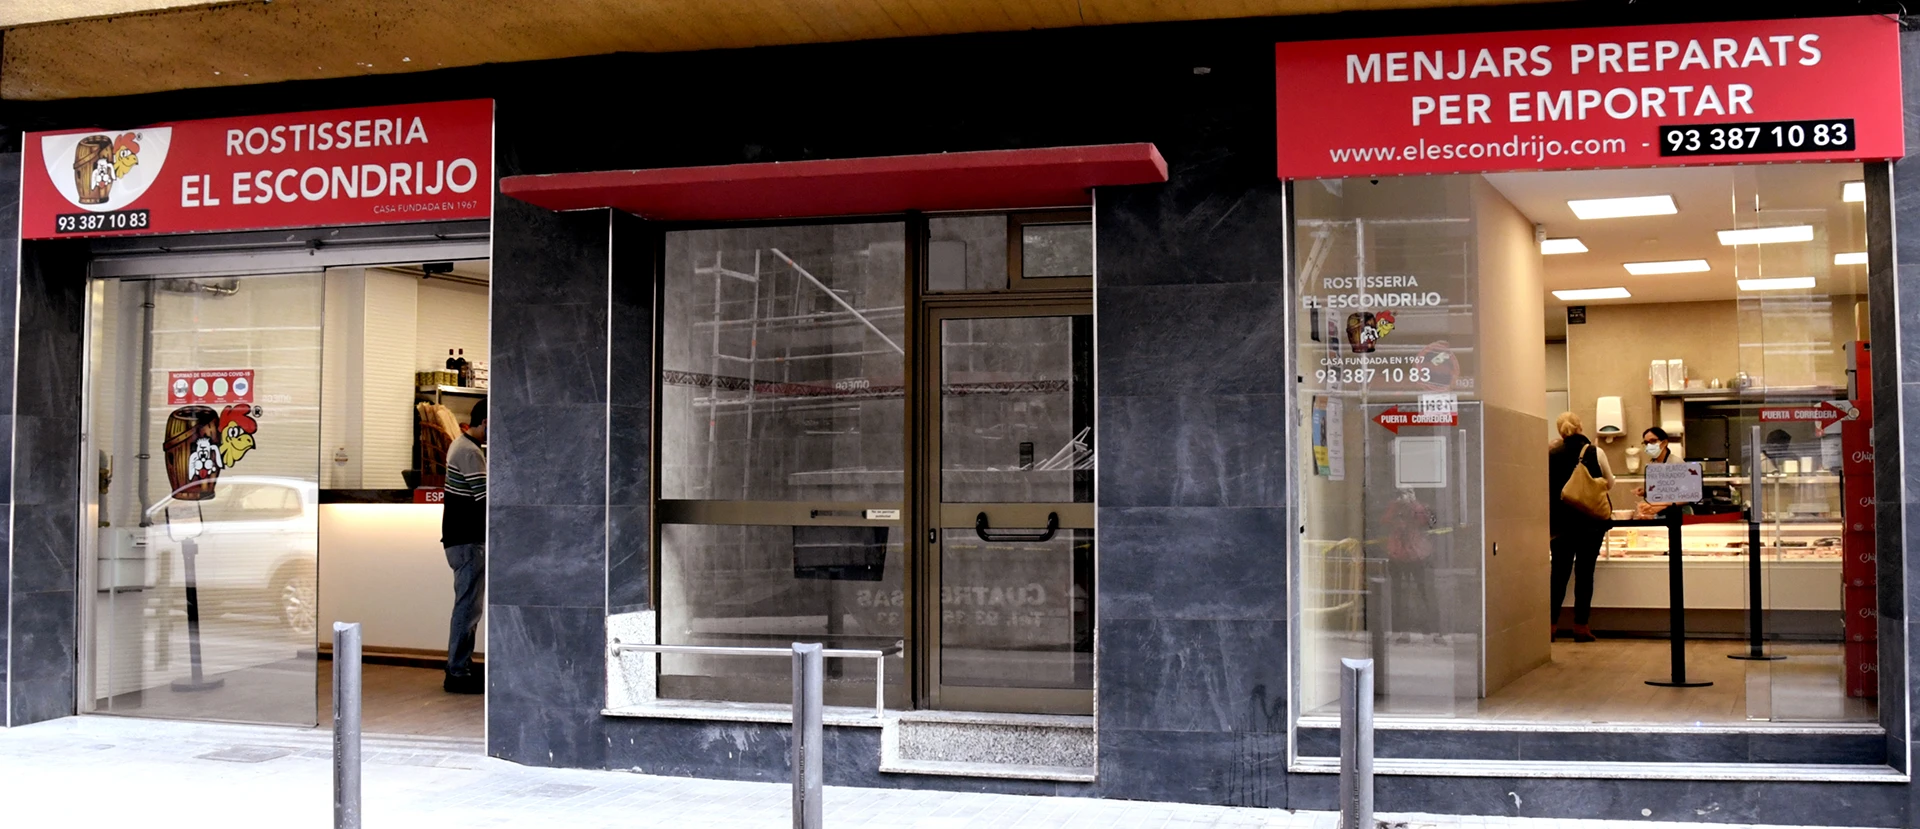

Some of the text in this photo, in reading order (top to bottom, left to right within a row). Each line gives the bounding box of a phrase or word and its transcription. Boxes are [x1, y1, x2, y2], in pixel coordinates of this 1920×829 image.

[1346, 33, 1823, 84] MENJARS PREPARATS
[1411, 83, 1754, 126] PER EMPORTAR
[226, 116, 429, 156] ROSTISSERIA
[1329, 134, 1626, 163] www.elescondrijo.com
[1666, 129, 1701, 152] 93
[1709, 127, 1761, 150] 387
[1770, 125, 1805, 148] 10
[1813, 123, 1848, 147] 83
[181, 157, 478, 207] EL ESCONDRIJO
[373, 200, 478, 214] CASA FUNDADA EN 1967
[58, 212, 147, 231] 93 387 10 83
[1323, 275, 1418, 289] ROSTISSERIA
[1302, 291, 1441, 309] EL ESCONDRIJO
[1320, 356, 1425, 366] CASA FUNDADA EN 1967
[1315, 367, 1431, 383] 93 387 10 83
[1381, 414, 1453, 423] PUERTA CORREDERA
[1762, 410, 1838, 419] PUERTA CORREDERA
